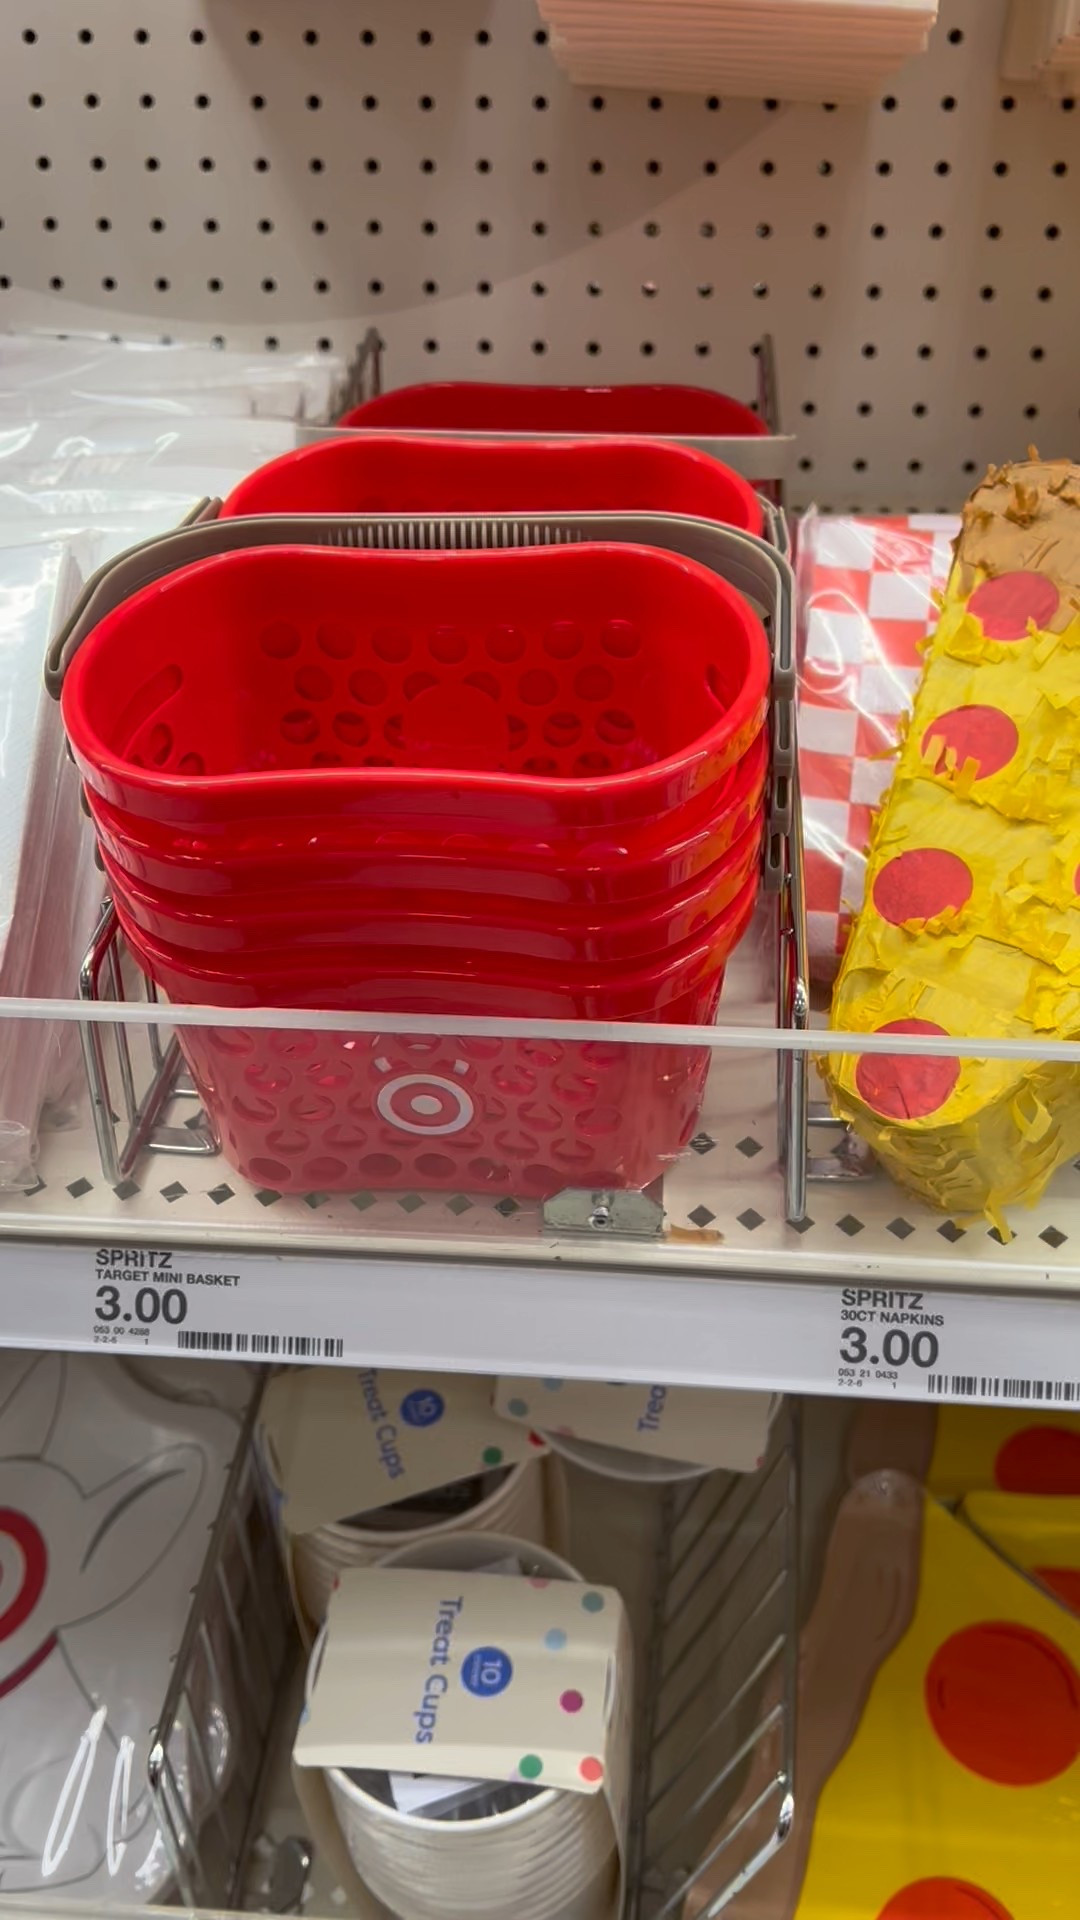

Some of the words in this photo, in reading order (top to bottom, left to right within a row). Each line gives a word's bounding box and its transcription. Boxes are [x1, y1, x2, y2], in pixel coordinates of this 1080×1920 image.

[96, 1249, 172, 1268] SPRITZ
[95, 1269, 149, 1282] TARGET
[152, 1272, 182, 1283] MINI
[186, 1274, 240, 1286] BASKET
[95, 1285, 188, 1325] 3.00
[841, 1288, 923, 1310] SPRITZ
[840, 1309, 876, 1322] 30CT
[880, 1312, 944, 1327] NAPKINS
[840, 1326, 939, 1368] 3.00
[838, 1368, 855, 1377] 053
[859, 1369, 870, 1378] 21
[875, 1370, 898, 1380] 0433
[838, 1378, 863, 1387] 2-2-6
[636, 1384, 667, 1432] Trea
[375, 1425, 406, 1479] Cups
[430, 1596, 464, 1666] Treat
[480, 1659, 503, 1685] 10
[413, 1674, 448, 1744] Cups
